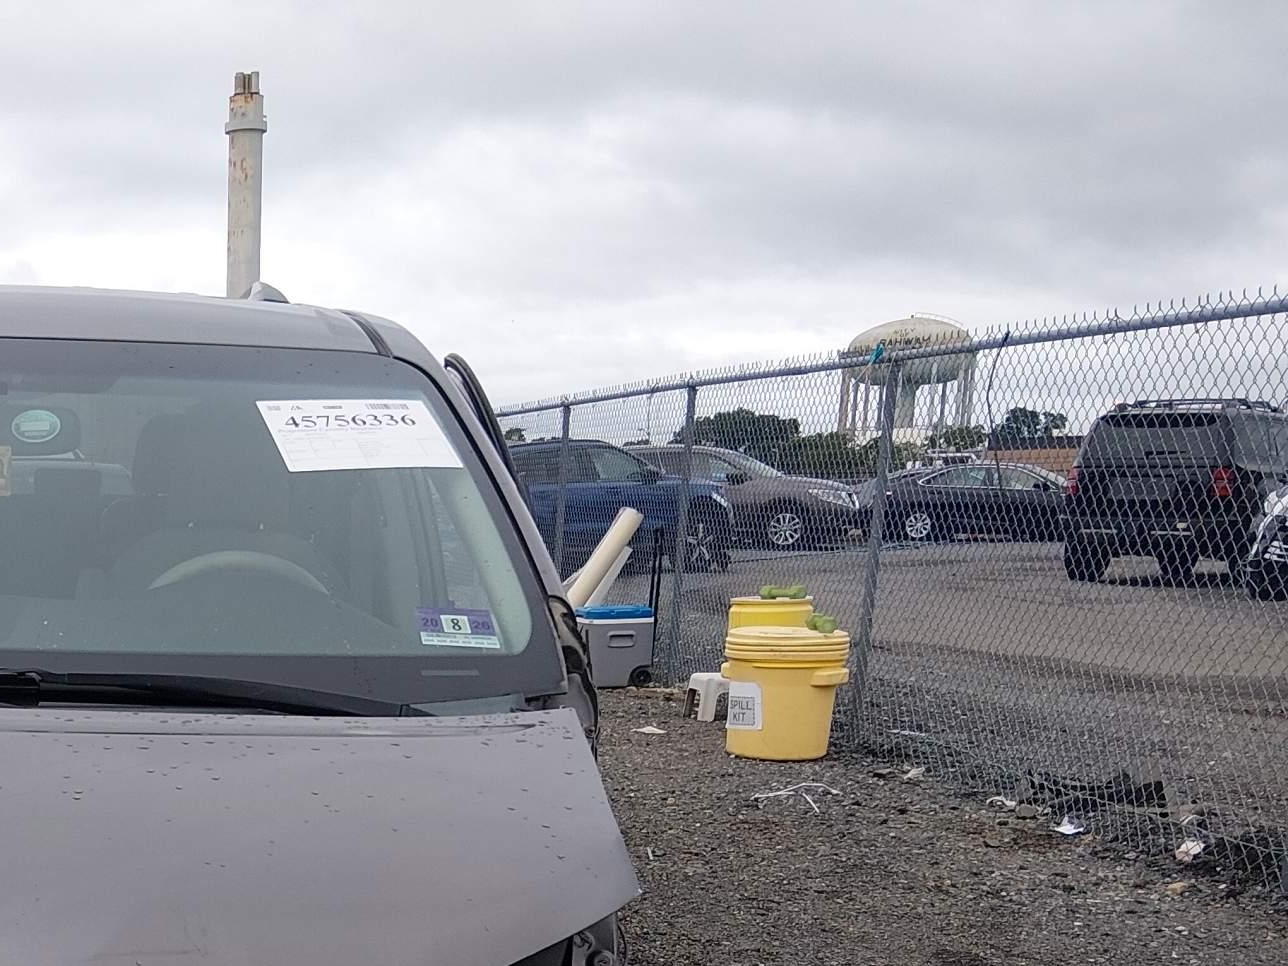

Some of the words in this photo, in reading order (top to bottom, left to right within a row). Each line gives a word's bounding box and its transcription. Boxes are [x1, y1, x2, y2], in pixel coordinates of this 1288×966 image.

[285, 413, 417, 429] 45756336
[422, 617, 439, 628] 20
[450, 617, 462, 632] 8
[730, 699, 752, 710] SPILL
[732, 711, 746, 721] KIT
